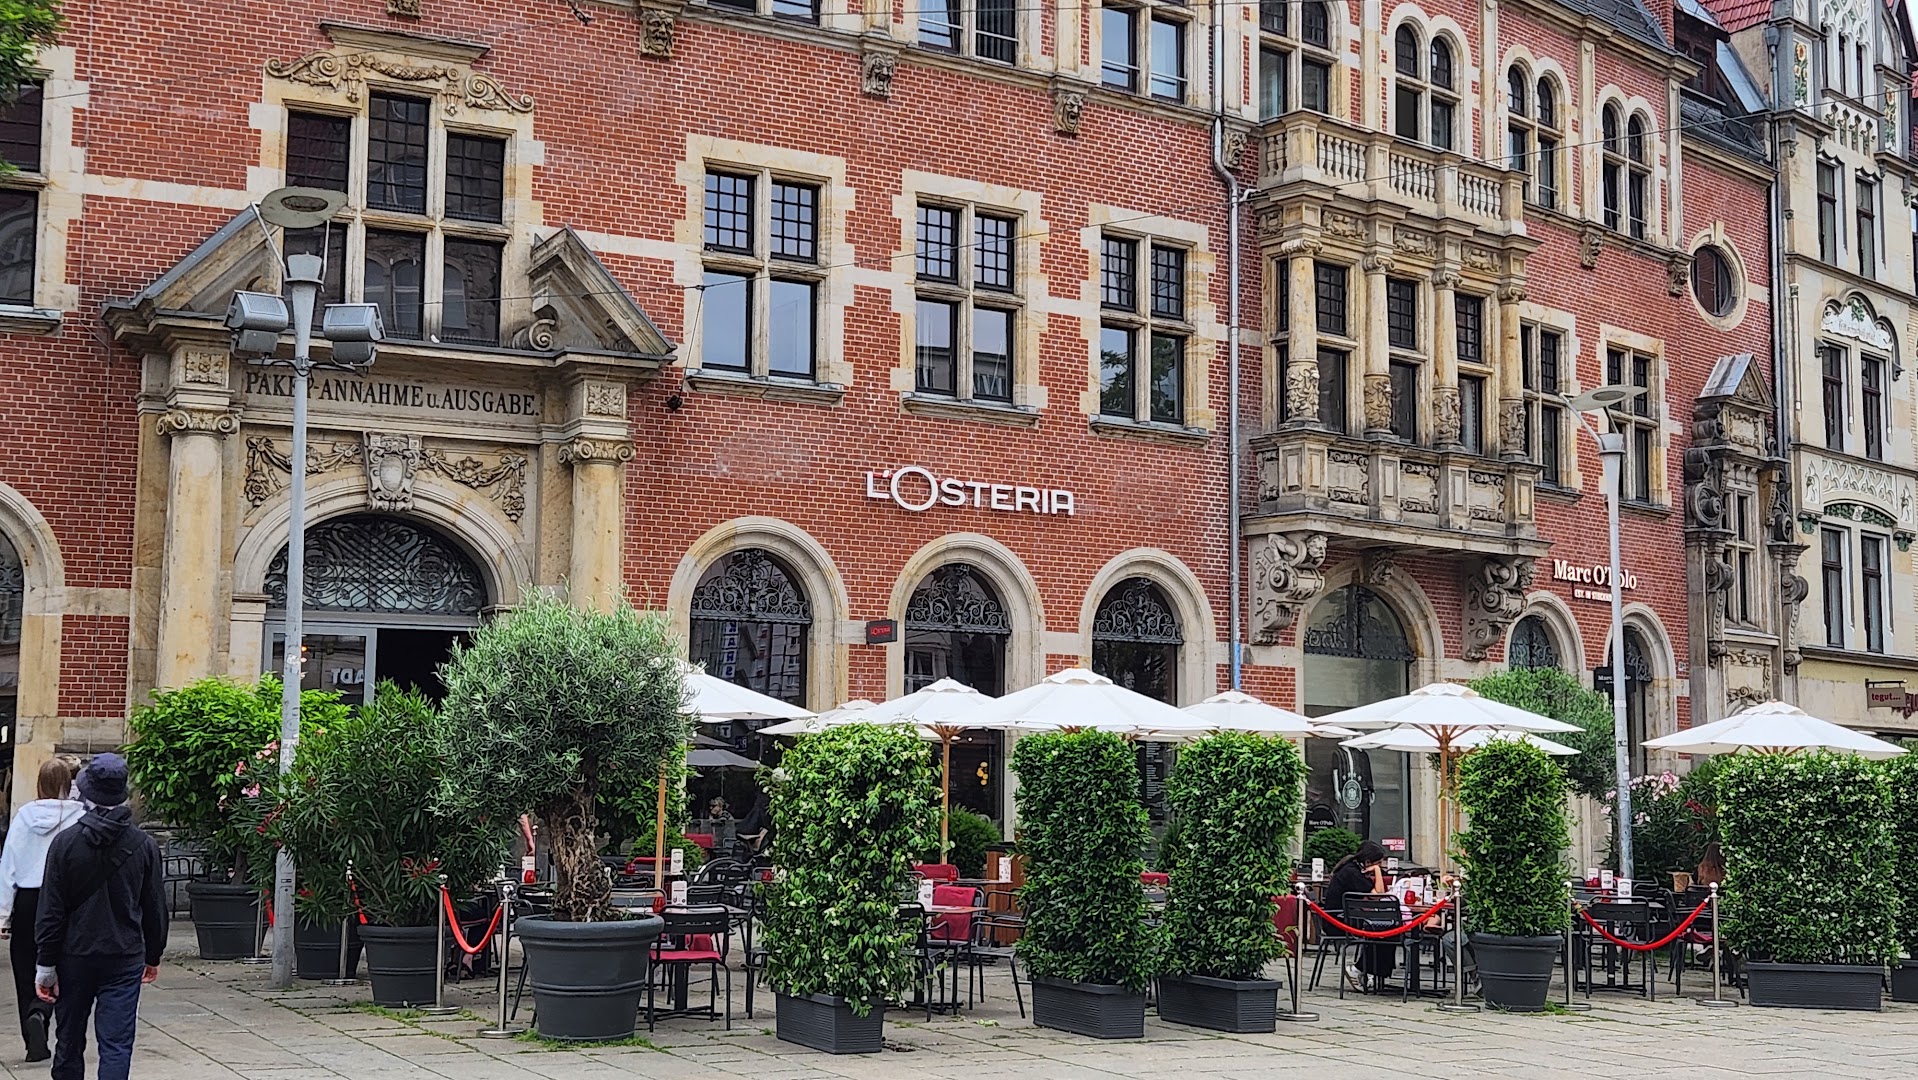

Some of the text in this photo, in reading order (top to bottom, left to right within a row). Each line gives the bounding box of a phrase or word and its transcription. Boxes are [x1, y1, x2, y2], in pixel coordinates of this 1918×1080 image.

[441, 389, 539, 416] AUSGABE.
[865, 465, 1075, 516] L'OSTERIA
[1553, 559, 1591, 583] Marc
